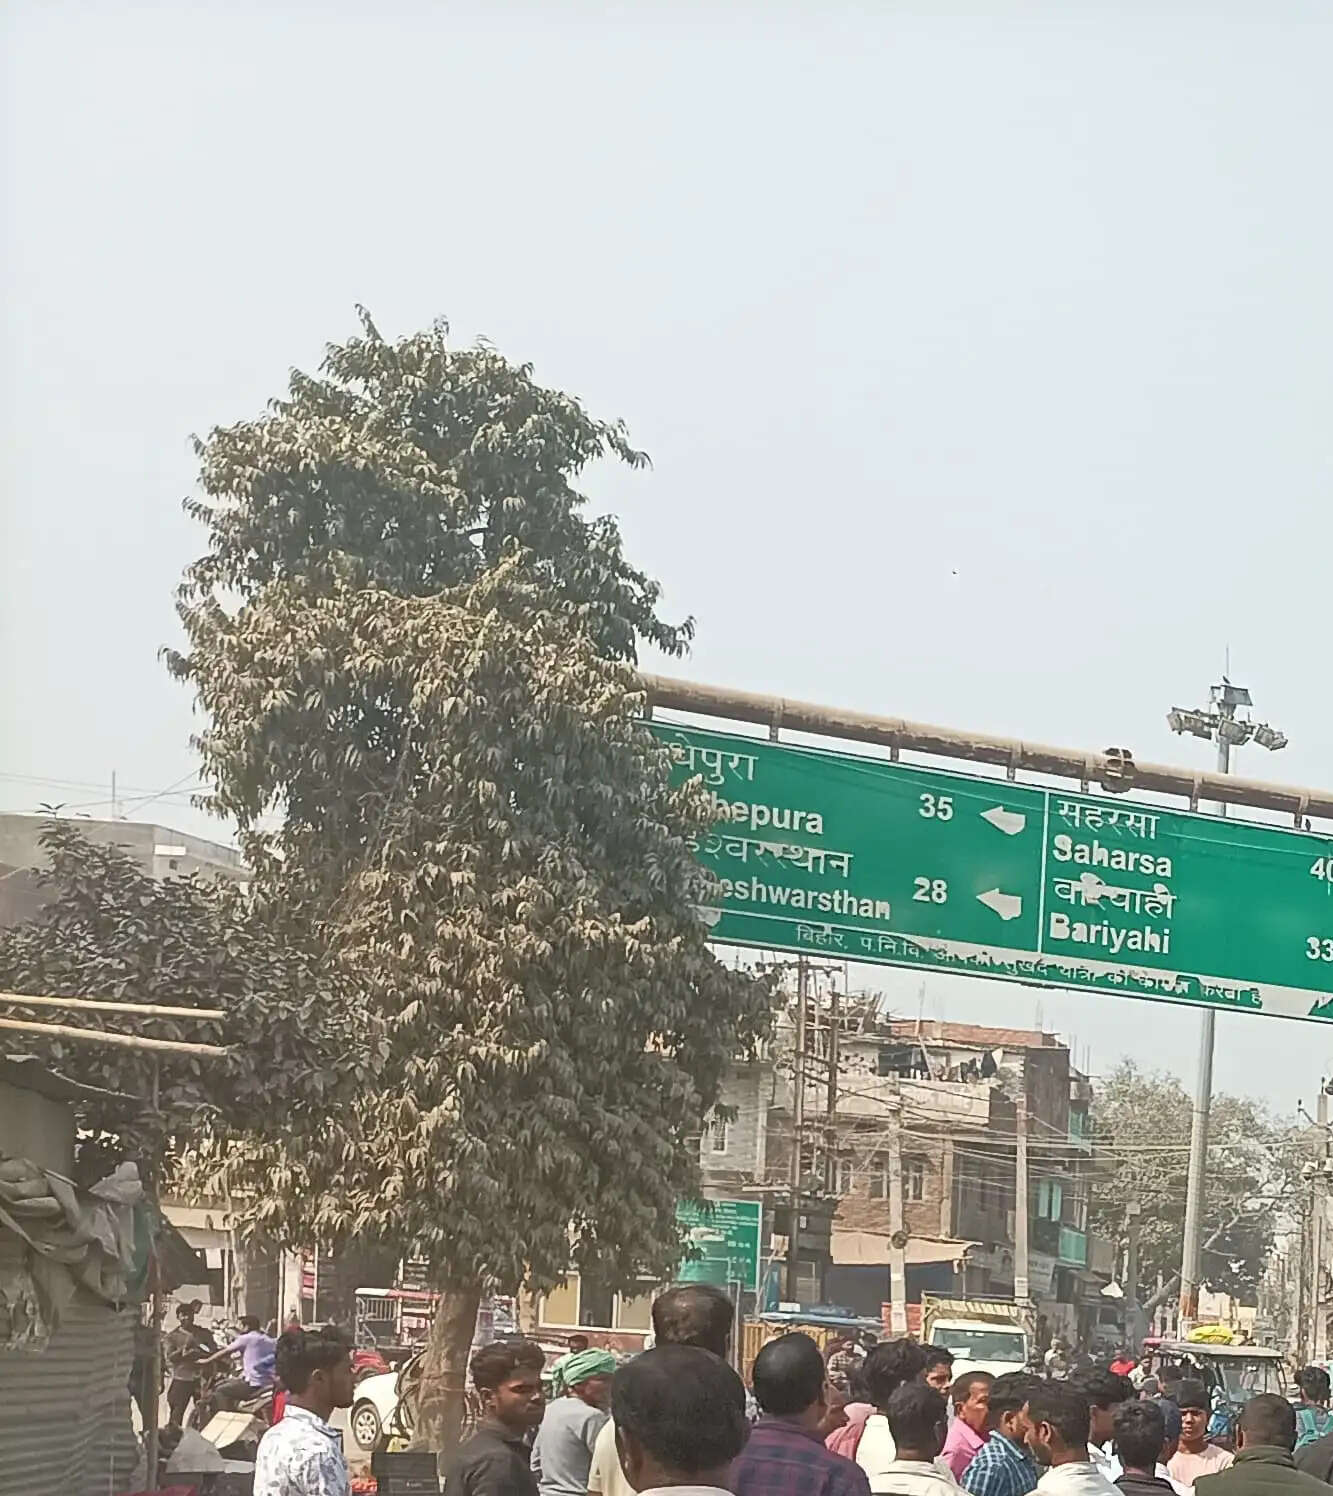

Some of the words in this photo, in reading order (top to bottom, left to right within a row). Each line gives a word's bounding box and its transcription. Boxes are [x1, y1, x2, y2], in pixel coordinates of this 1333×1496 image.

[918, 792, 953, 822] 35
[1057, 800, 1160, 840] सहरसा
[1052, 833, 1173, 878] Saharsa
[912, 876, 948, 905] 28
[1049, 912, 1171, 955] Bariyahi
